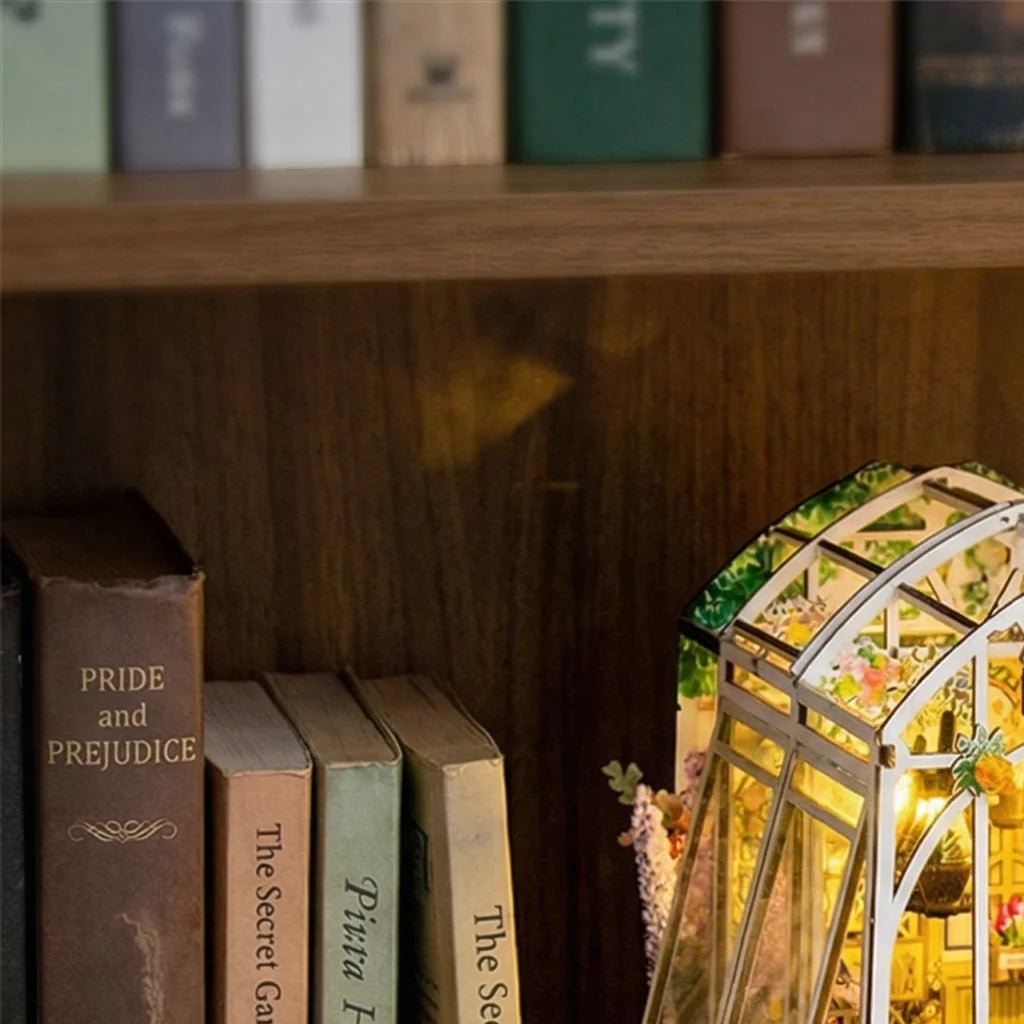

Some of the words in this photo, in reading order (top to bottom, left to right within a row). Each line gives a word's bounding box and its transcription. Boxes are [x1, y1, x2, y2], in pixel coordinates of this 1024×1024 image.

[80, 665, 166, 692] PRIDE
[98, 703, 148, 728] and
[47, 736, 197, 772] PREJUDICE
[255, 822, 283, 879] The
[255, 885, 283, 971] Secret
[473, 904, 506, 972] The
